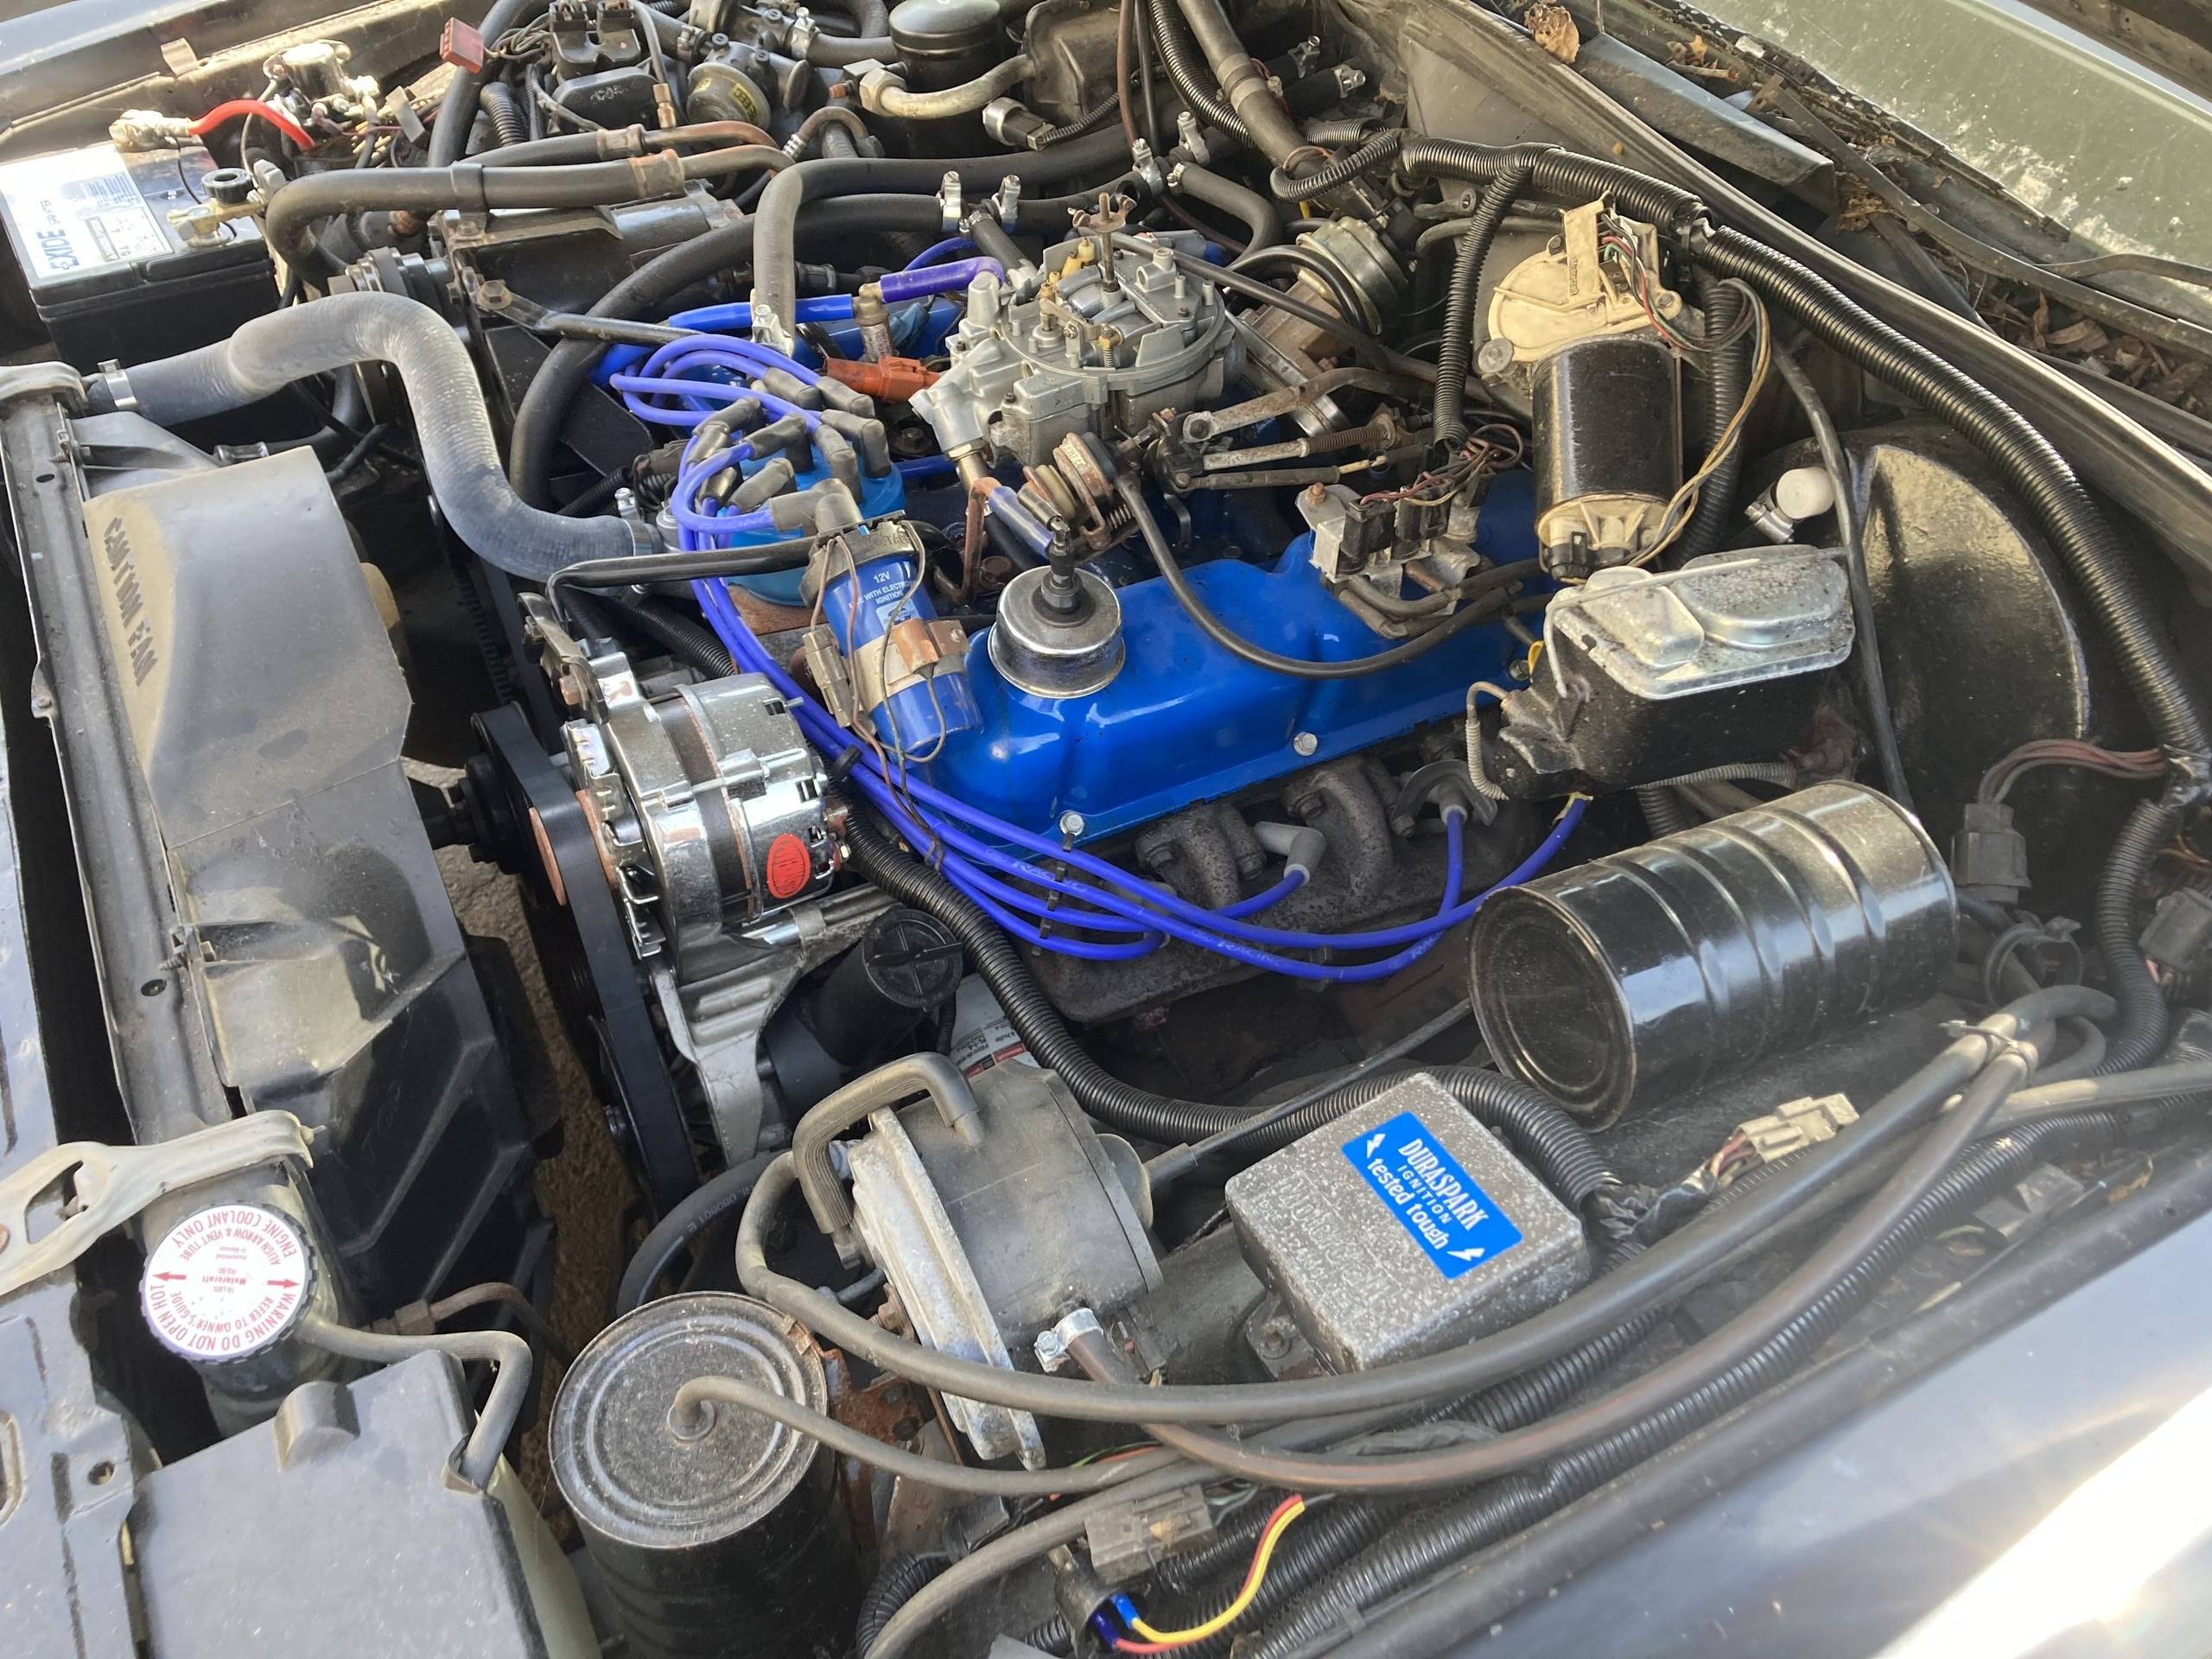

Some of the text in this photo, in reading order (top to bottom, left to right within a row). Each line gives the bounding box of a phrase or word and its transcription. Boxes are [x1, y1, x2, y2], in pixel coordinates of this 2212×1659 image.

[36, 229, 79, 270] EXIDE
[864, 588, 882, 601] WITH
[873, 570, 891, 584] 12V
[874, 591, 905, 605] IGNITION
[127, 616, 158, 687] FAN
[1367, 1158, 1450, 1252] tested tough
[1395, 1165, 1452, 1225] IGNITION
[1396, 1137, 1491, 1232] DURASPARK
[170, 1210, 296, 1257] ENGINE COOLANT ONLY
[178, 1227, 281, 1265] ALIGN ARROW & VENT TUBE
[200, 1274, 246, 1285] Motorcraft
[149, 1283, 296, 1351] WARNING DO NOT OPEN HOT
[168, 1290, 273, 1332] REFER TO OWNER'S GUIDE
